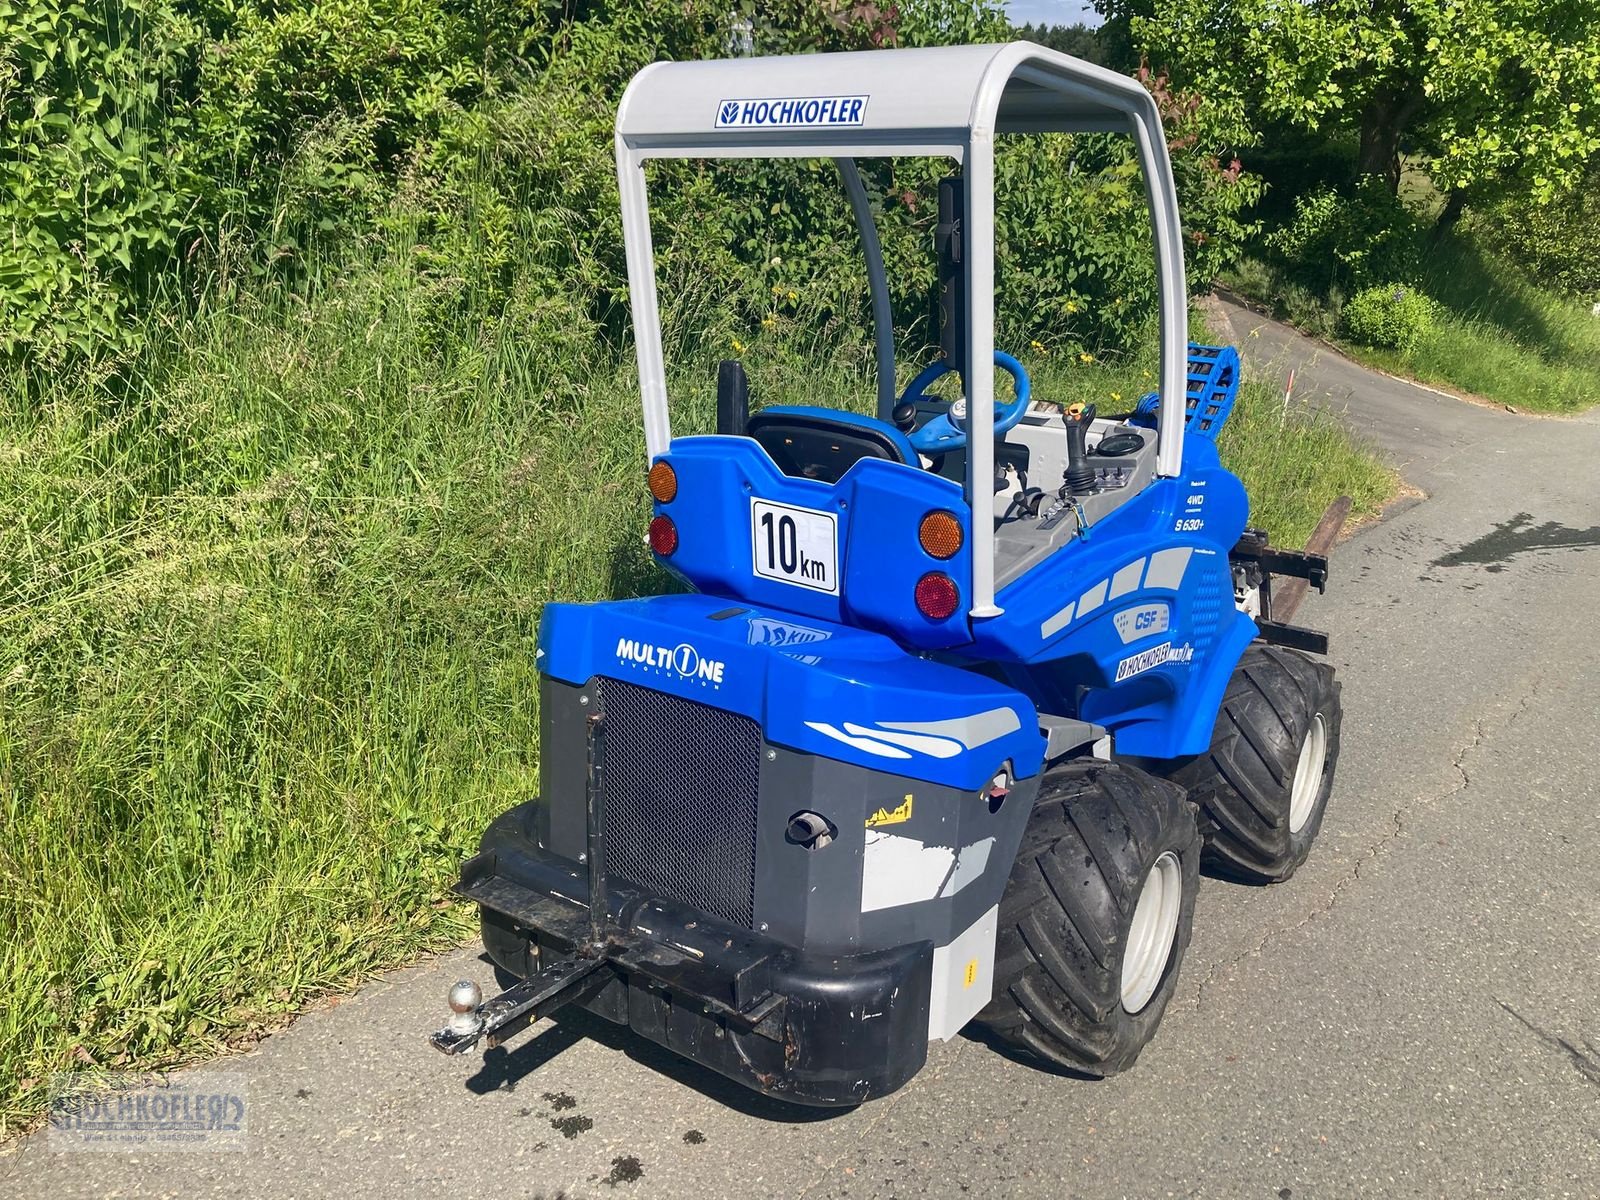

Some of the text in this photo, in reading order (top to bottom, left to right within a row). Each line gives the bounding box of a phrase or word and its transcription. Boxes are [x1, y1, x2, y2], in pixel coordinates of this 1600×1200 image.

[741, 99, 863, 124] HOCHKOFLER
[1187, 494, 1204, 505] 4WD
[1174, 519, 1205, 532] S 630+
[761, 512, 826, 582] 10 km
[1135, 610, 1157, 630] CSF
[1125, 643, 1169, 677] HOCHKOFLER
[620, 660, 719, 690] EVOLUTION
